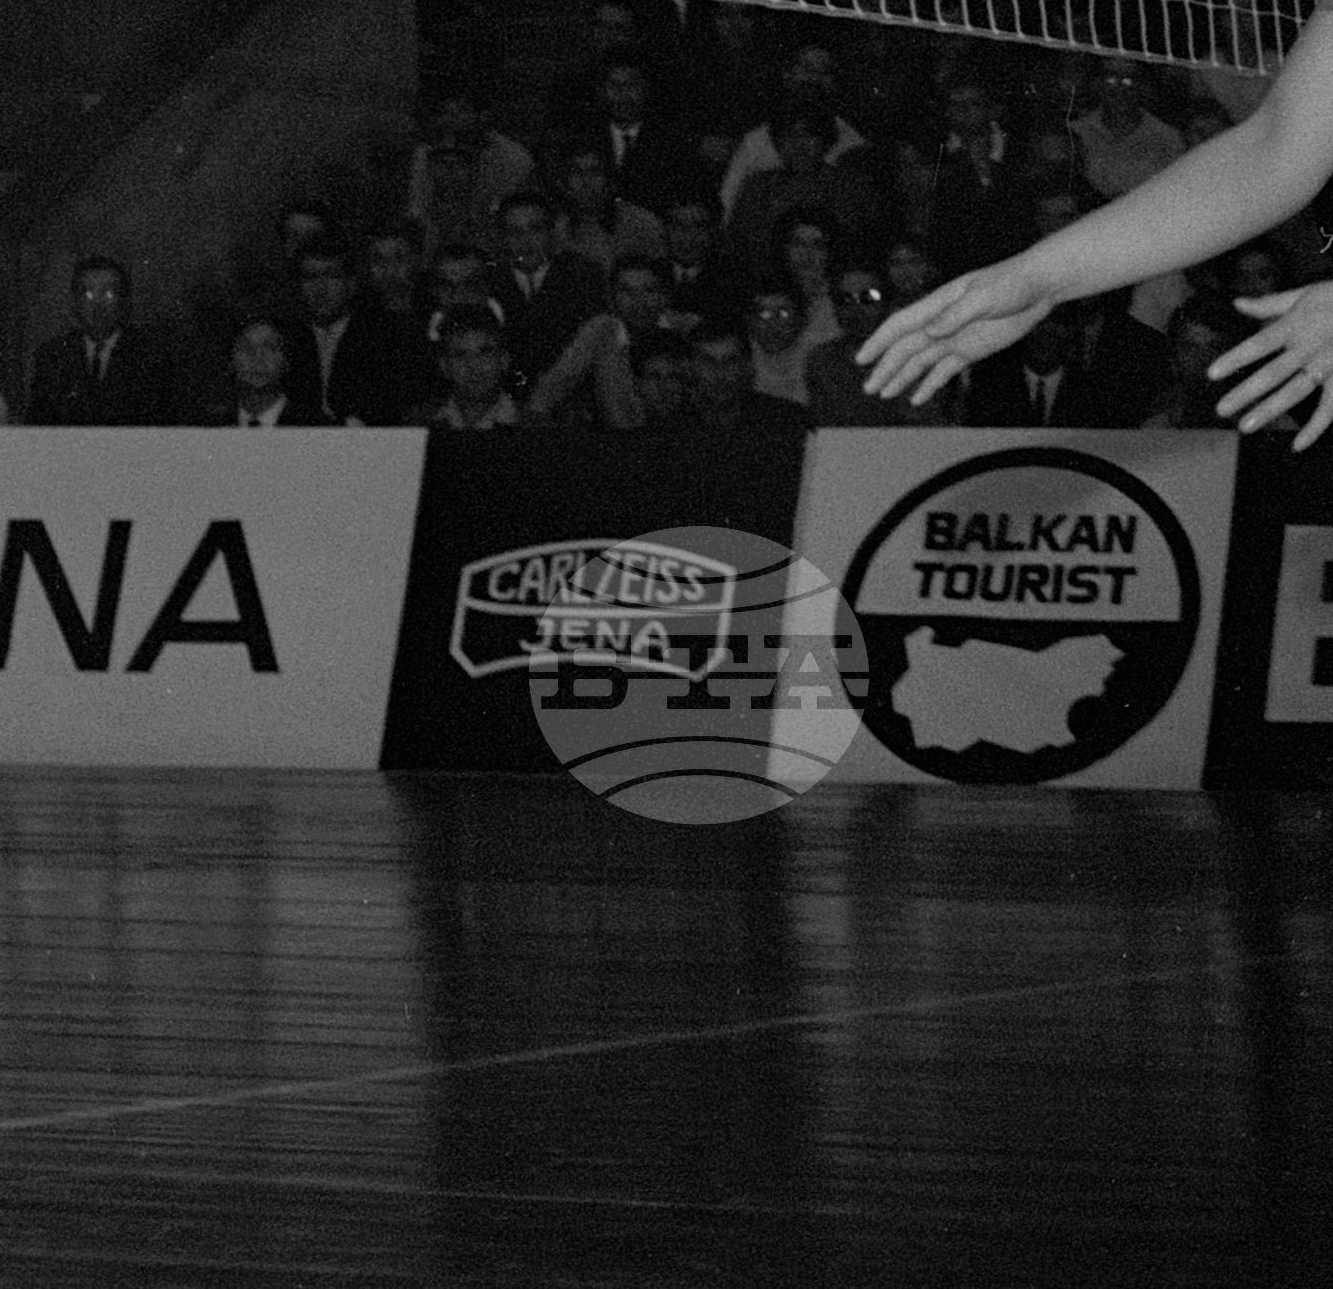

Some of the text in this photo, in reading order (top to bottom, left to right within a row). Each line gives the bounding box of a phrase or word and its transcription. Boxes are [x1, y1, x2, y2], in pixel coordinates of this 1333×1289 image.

[925, 512, 1136, 553] BALKAN
[914, 562, 1140, 605] TOURIST
[518, 618, 671, 659] JENA
